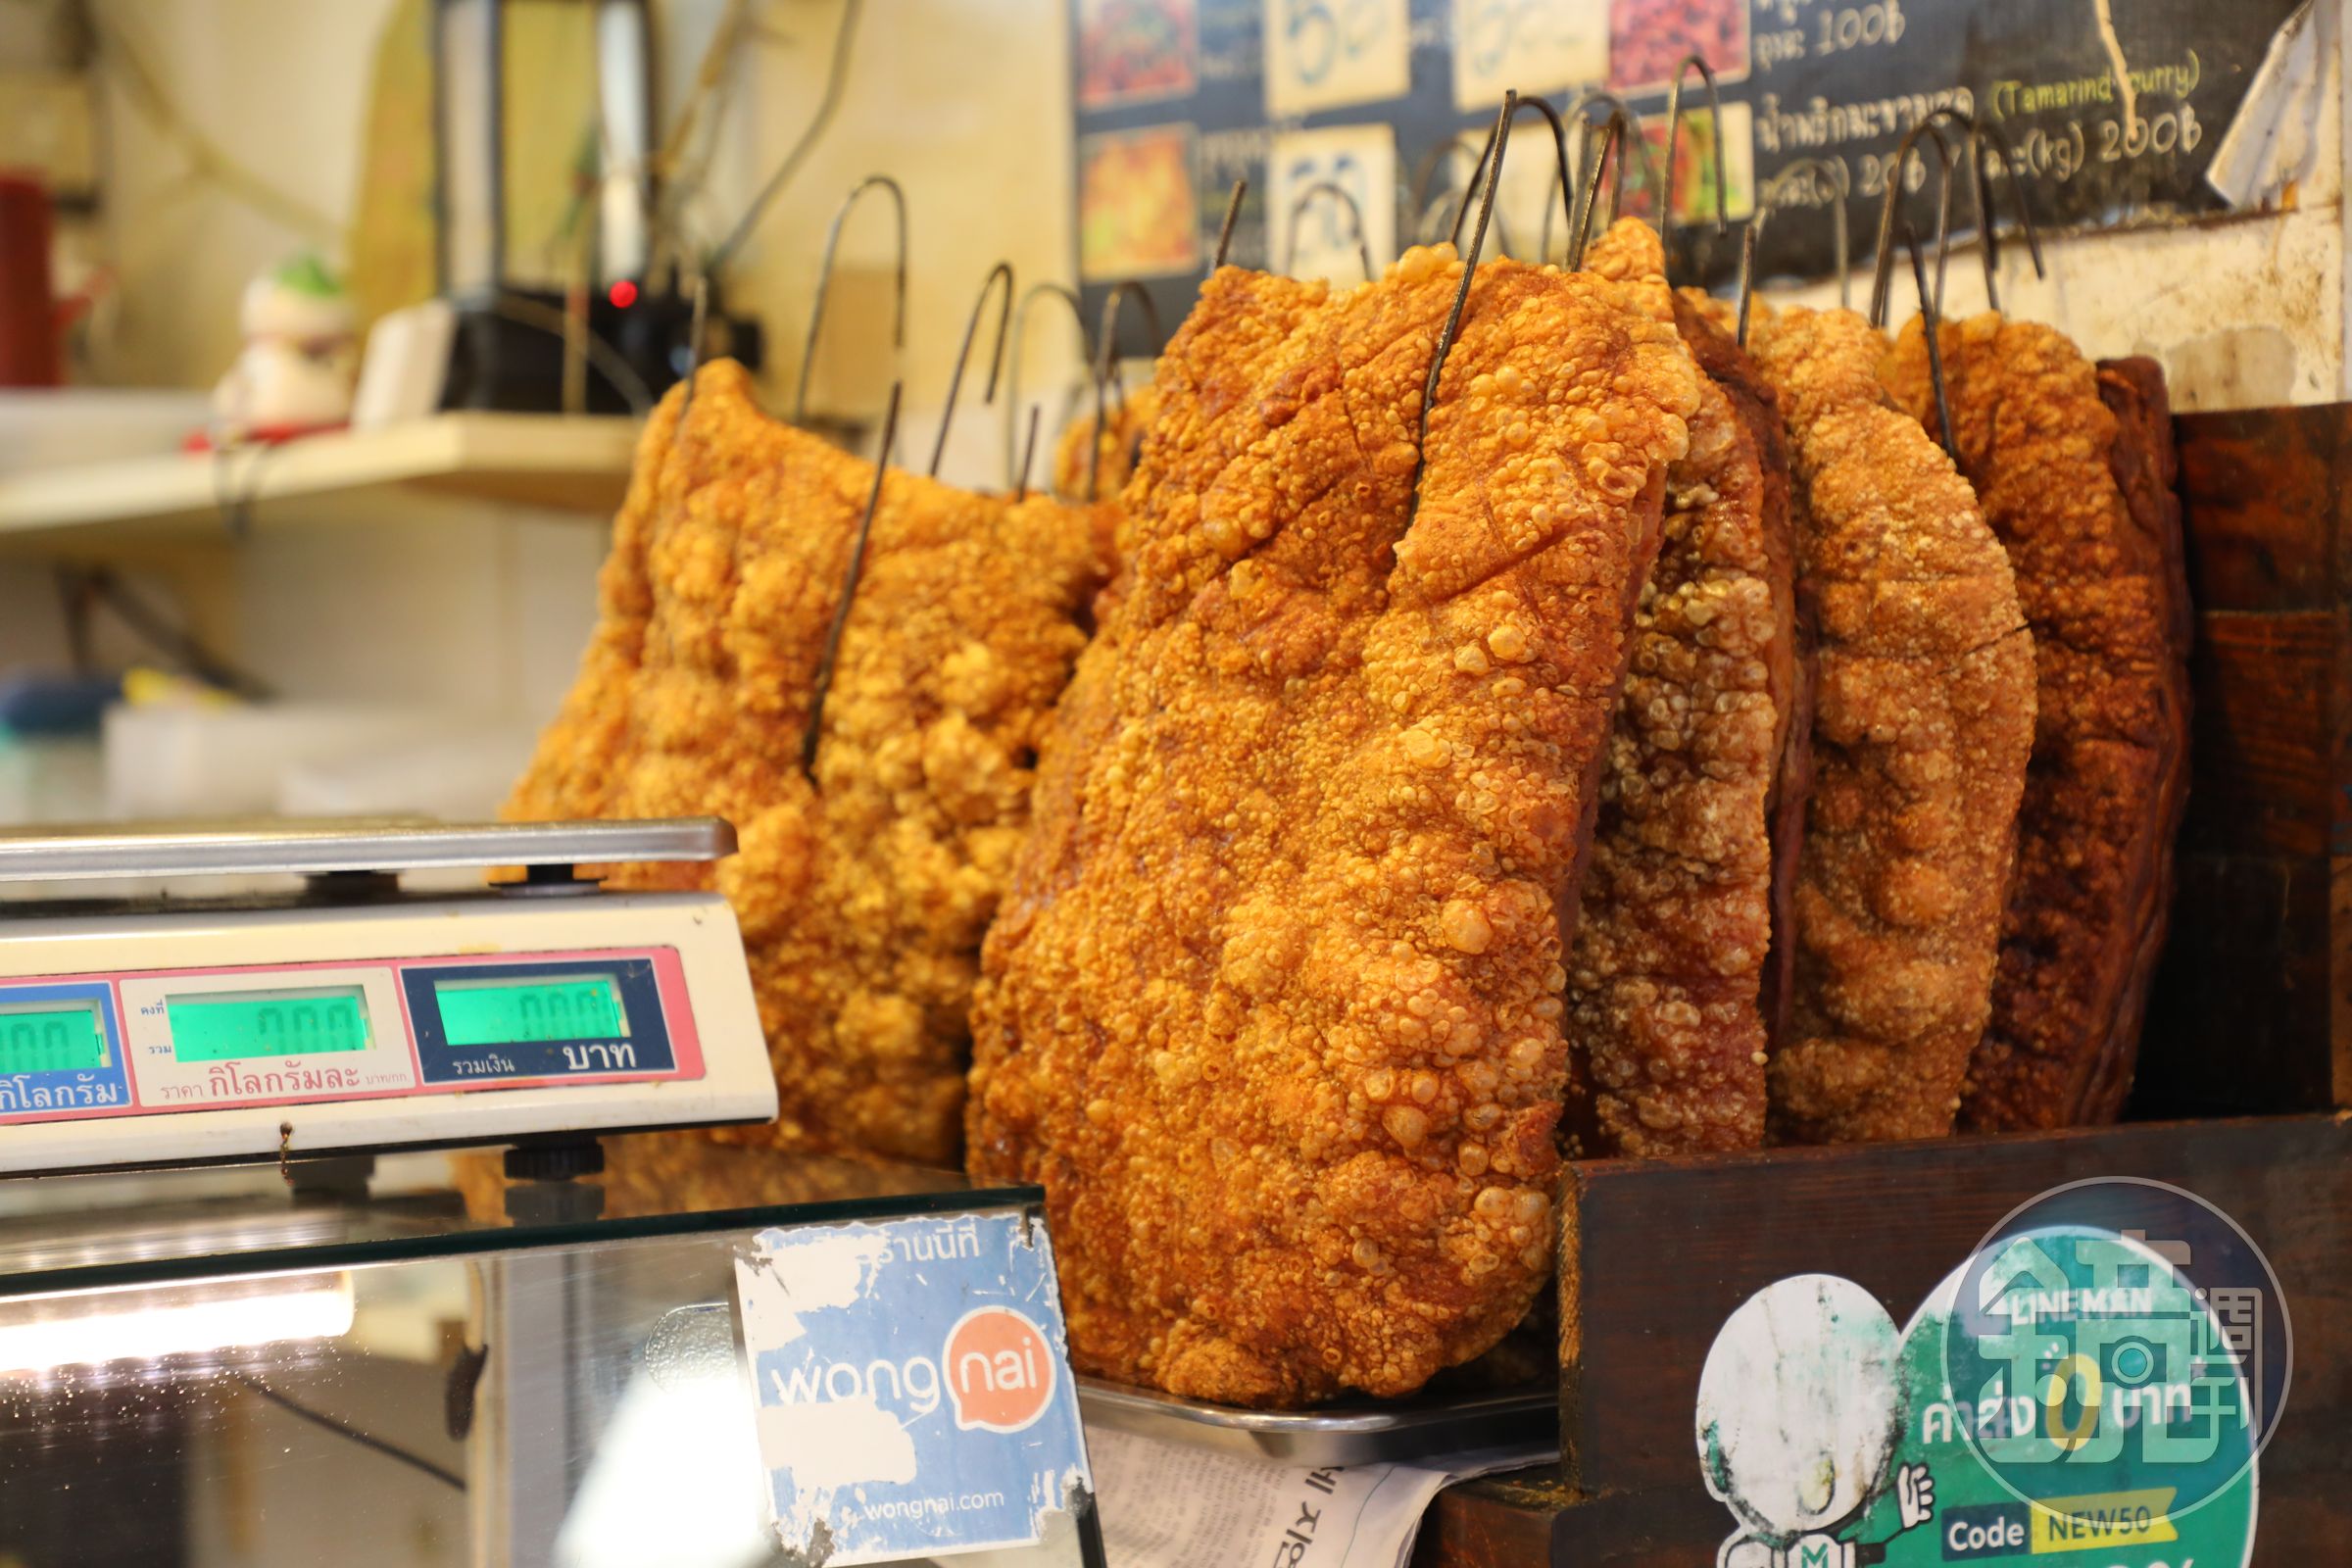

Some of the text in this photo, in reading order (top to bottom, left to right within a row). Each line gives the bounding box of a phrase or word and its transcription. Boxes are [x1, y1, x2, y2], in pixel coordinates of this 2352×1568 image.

[452, 1042, 637, 1075] รวมเงิน บาท
[160, 1084, 204, 1100] ราคา
[209, 1060, 361, 1099] กิโลกรัมละ
[2044, 1352, 2103, 1452] 0
[2113, 1381, 2192, 1431] บาท
[862, 1491, 1004, 1521] wongnai.com
[1948, 1504, 2151, 1551] Code NEW50
